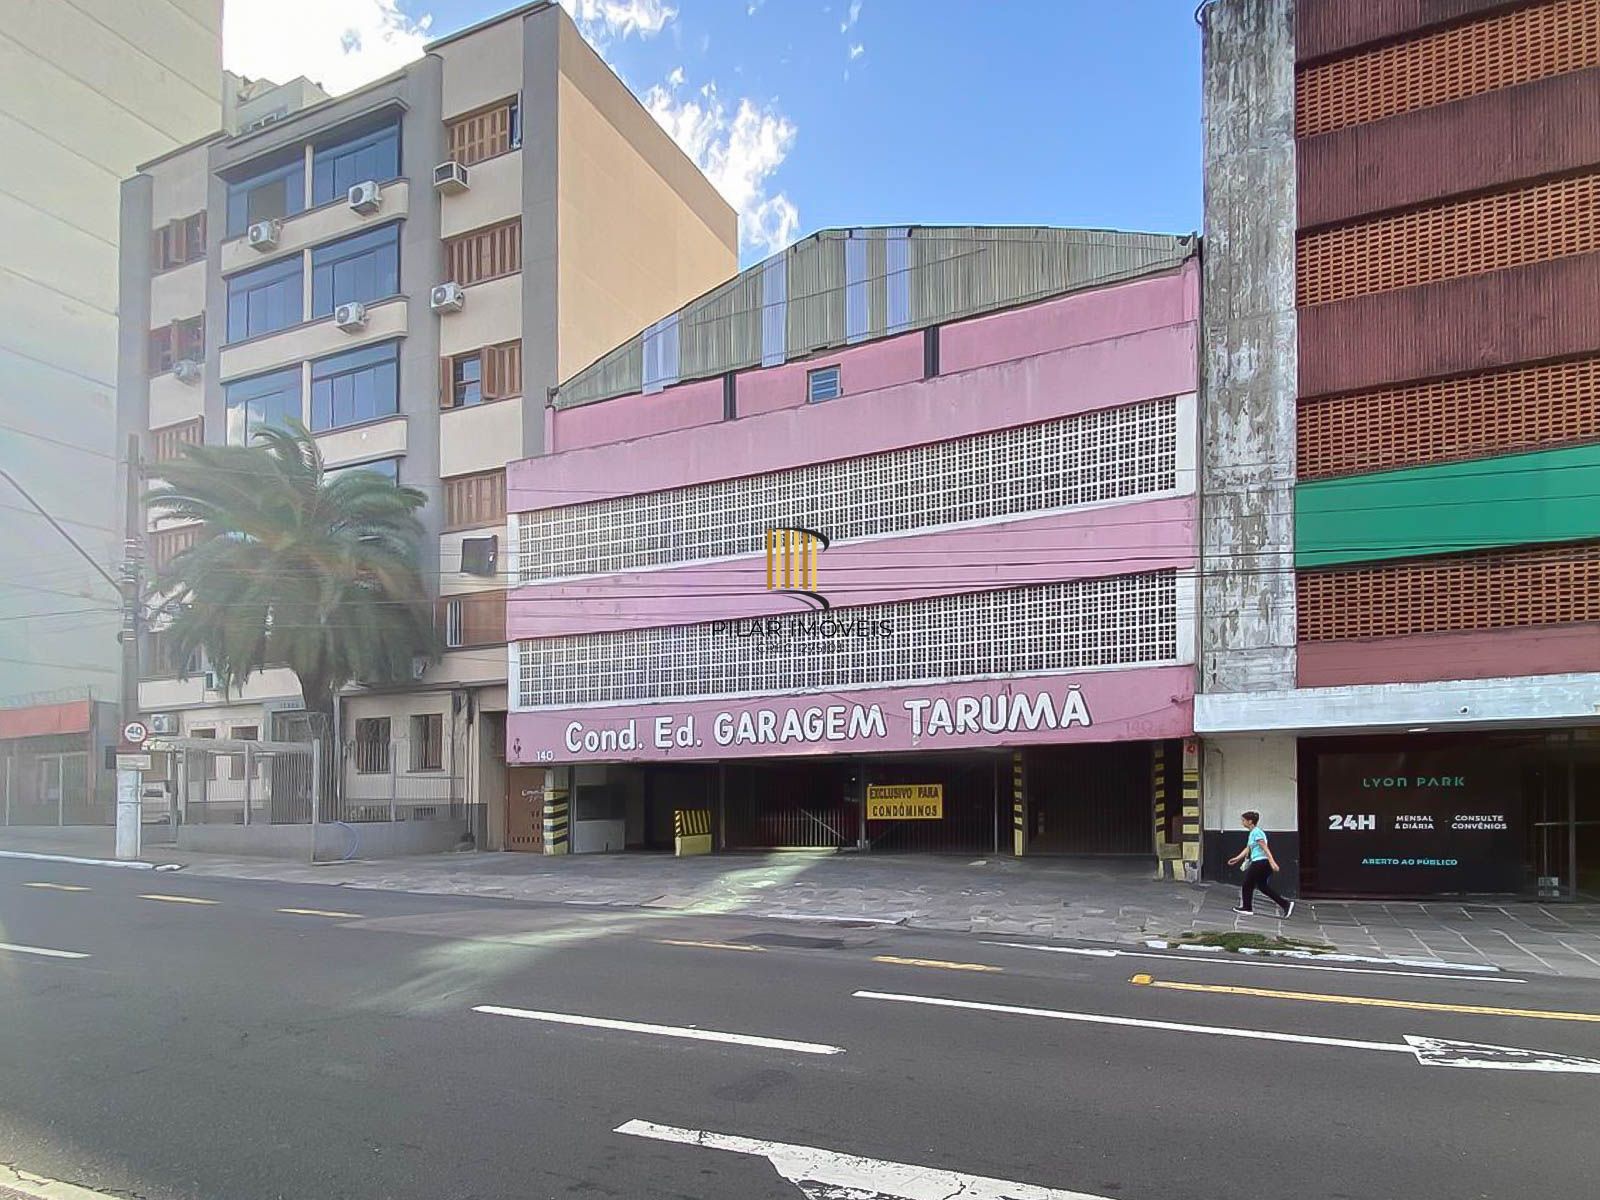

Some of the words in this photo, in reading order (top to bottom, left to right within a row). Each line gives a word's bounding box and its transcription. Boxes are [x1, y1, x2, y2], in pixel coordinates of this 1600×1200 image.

[565, 719, 644, 752] Cond.
[655, 715, 703, 748] Ed.
[713, 703, 887, 746] GARAGEM
[904, 683, 1093, 736] TARUMÃ
[127, 726, 143, 737] 40
[1363, 778, 1407, 787] LYON
[1417, 776, 1465, 787] PARK
[870, 787, 912, 799] EXCLUSIVO
[918, 786, 938, 798] PARA
[1328, 814, 1376, 830] 24H
[1402, 821, 1434, 830] DIÁRIA
[1451, 821, 1508, 830] CONVÊNIOS
[1361, 858, 1399, 866] ABERTO
[1417, 857, 1458, 866] PÚBLICO
